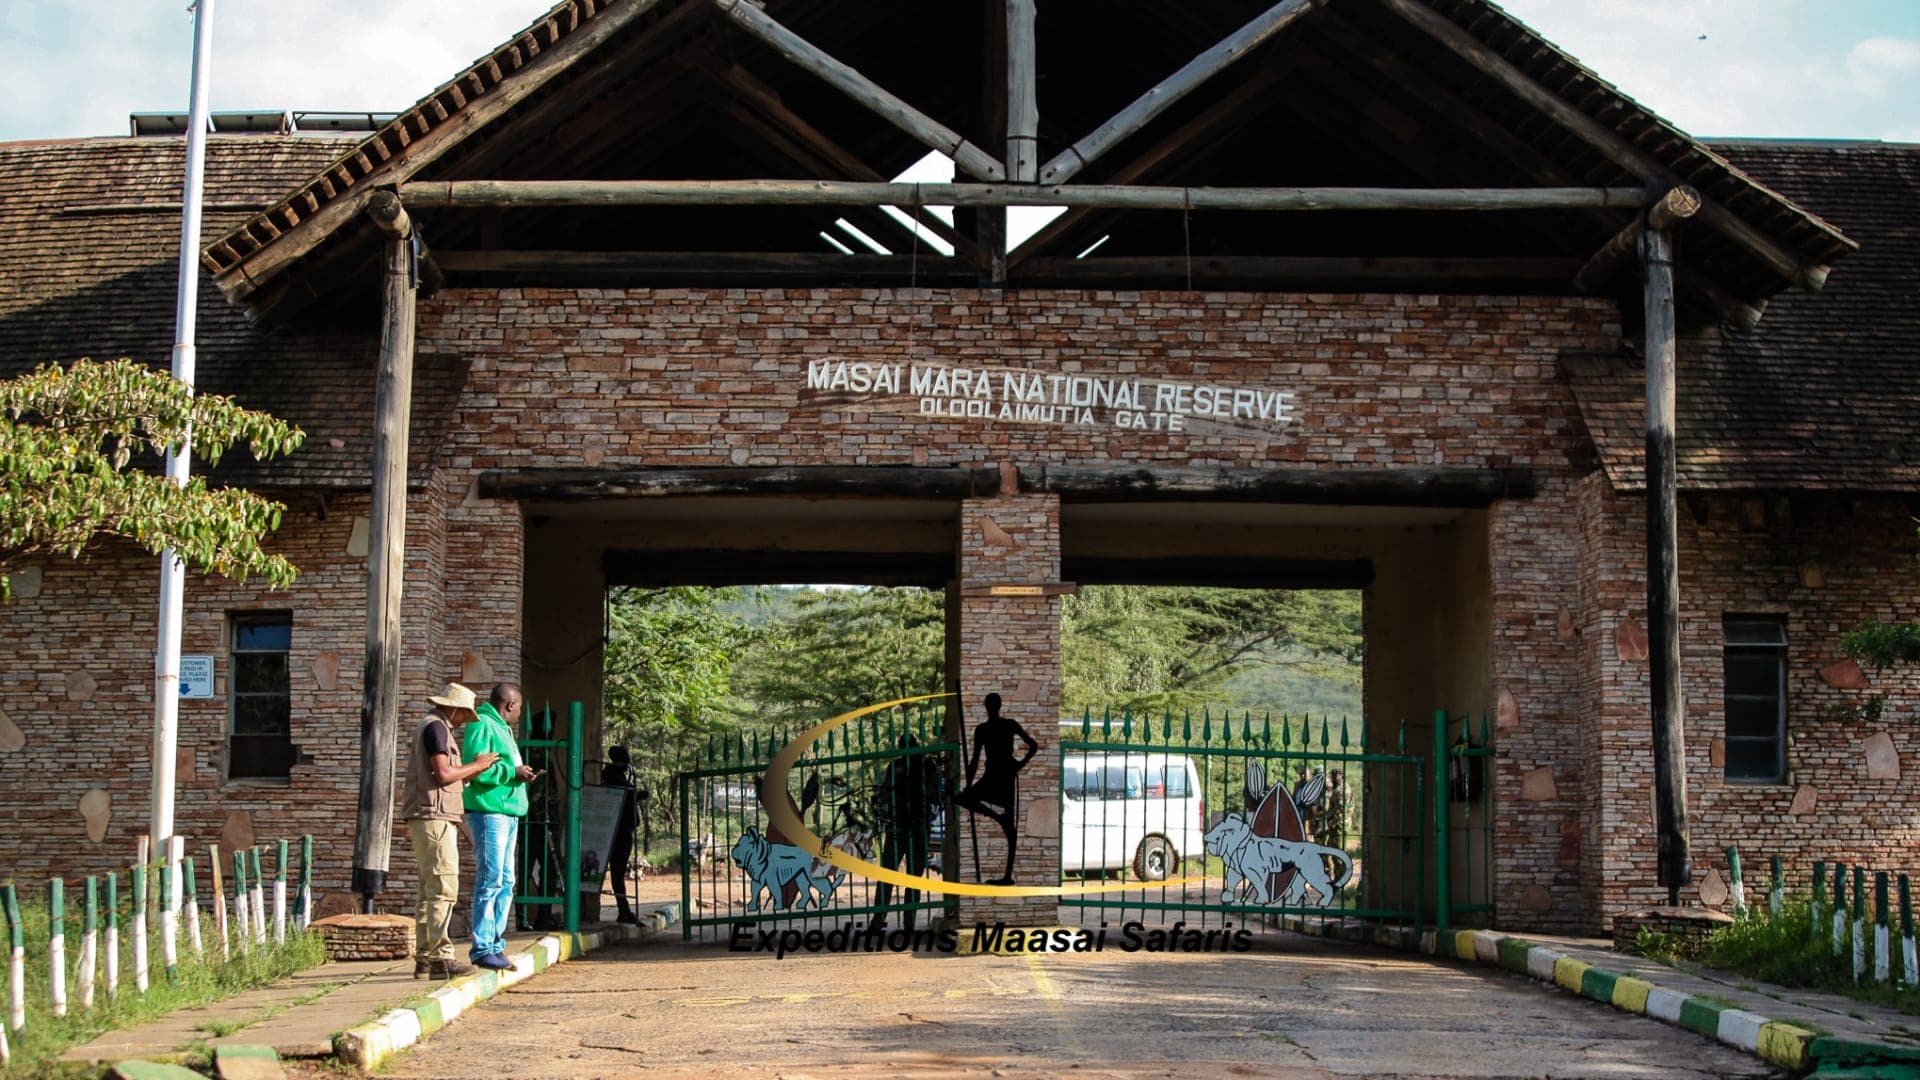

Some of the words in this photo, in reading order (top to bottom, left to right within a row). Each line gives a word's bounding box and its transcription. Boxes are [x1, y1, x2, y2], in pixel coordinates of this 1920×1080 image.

[806, 360, 900, 394] MASAI
[910, 365, 992, 399] MARA
[1002, 373, 1145, 411] NATIONAL
[1155, 383, 1295, 421] RESERVE
[920, 398, 1095, 425] OLOOLAIMUTIA
[1116, 409, 1183, 431] GATE
